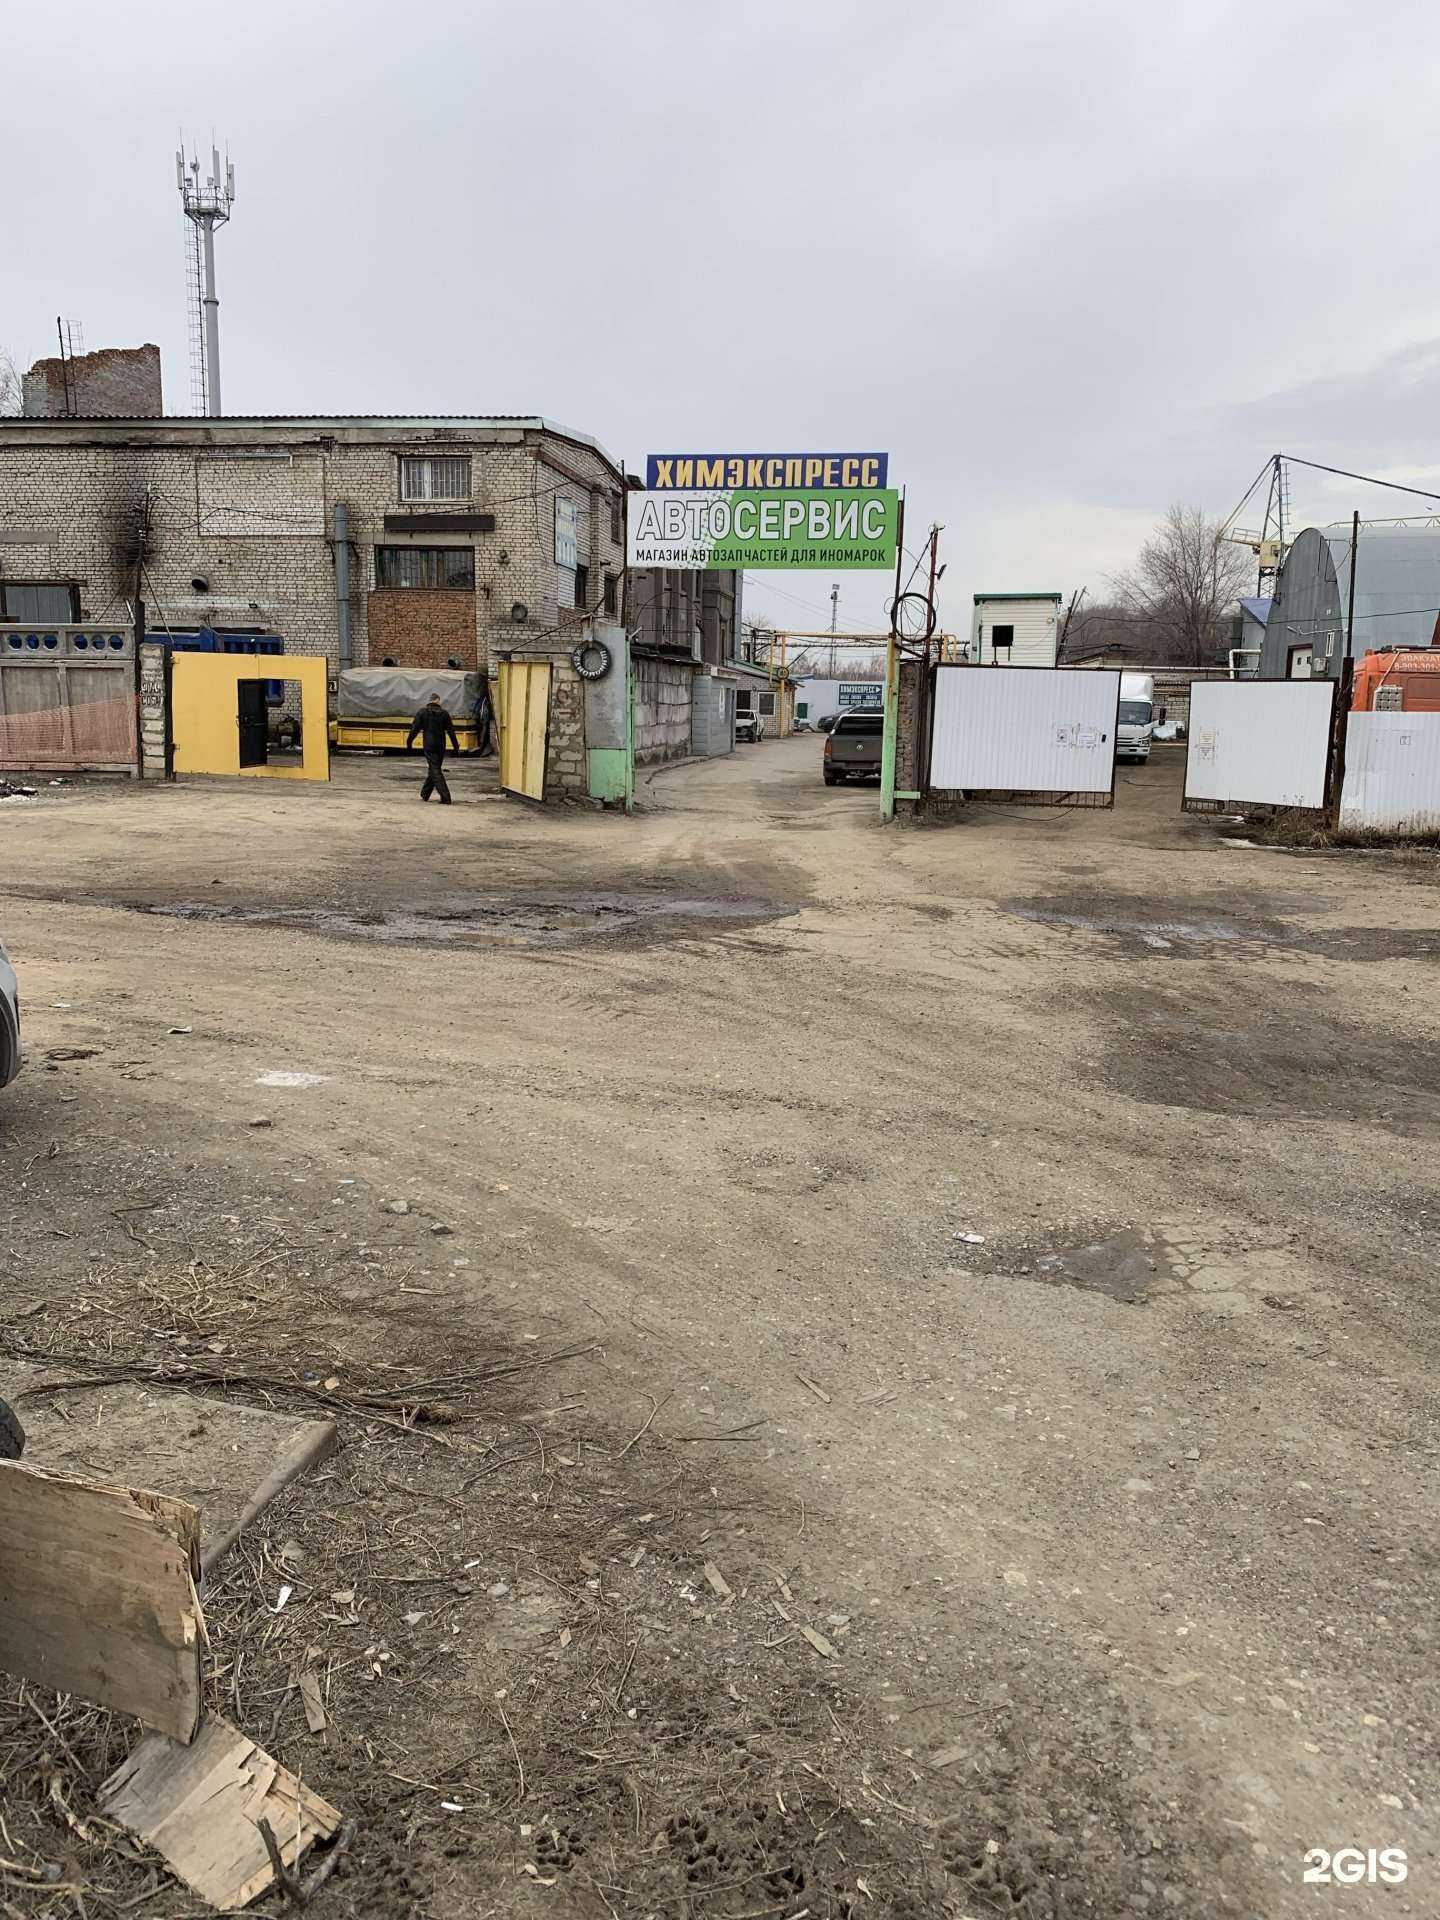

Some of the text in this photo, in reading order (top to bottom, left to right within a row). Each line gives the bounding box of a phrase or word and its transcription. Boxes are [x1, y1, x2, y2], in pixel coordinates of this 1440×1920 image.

[656, 458, 879, 488] ХИМЭКСПРЕСС
[636, 499, 885, 540] АВТОСЕРВИС
[636, 547, 885, 563] МАГАЗИН АВТОЗАПЧАСТЕЙ ДЛЯ ИНОМАРОК
